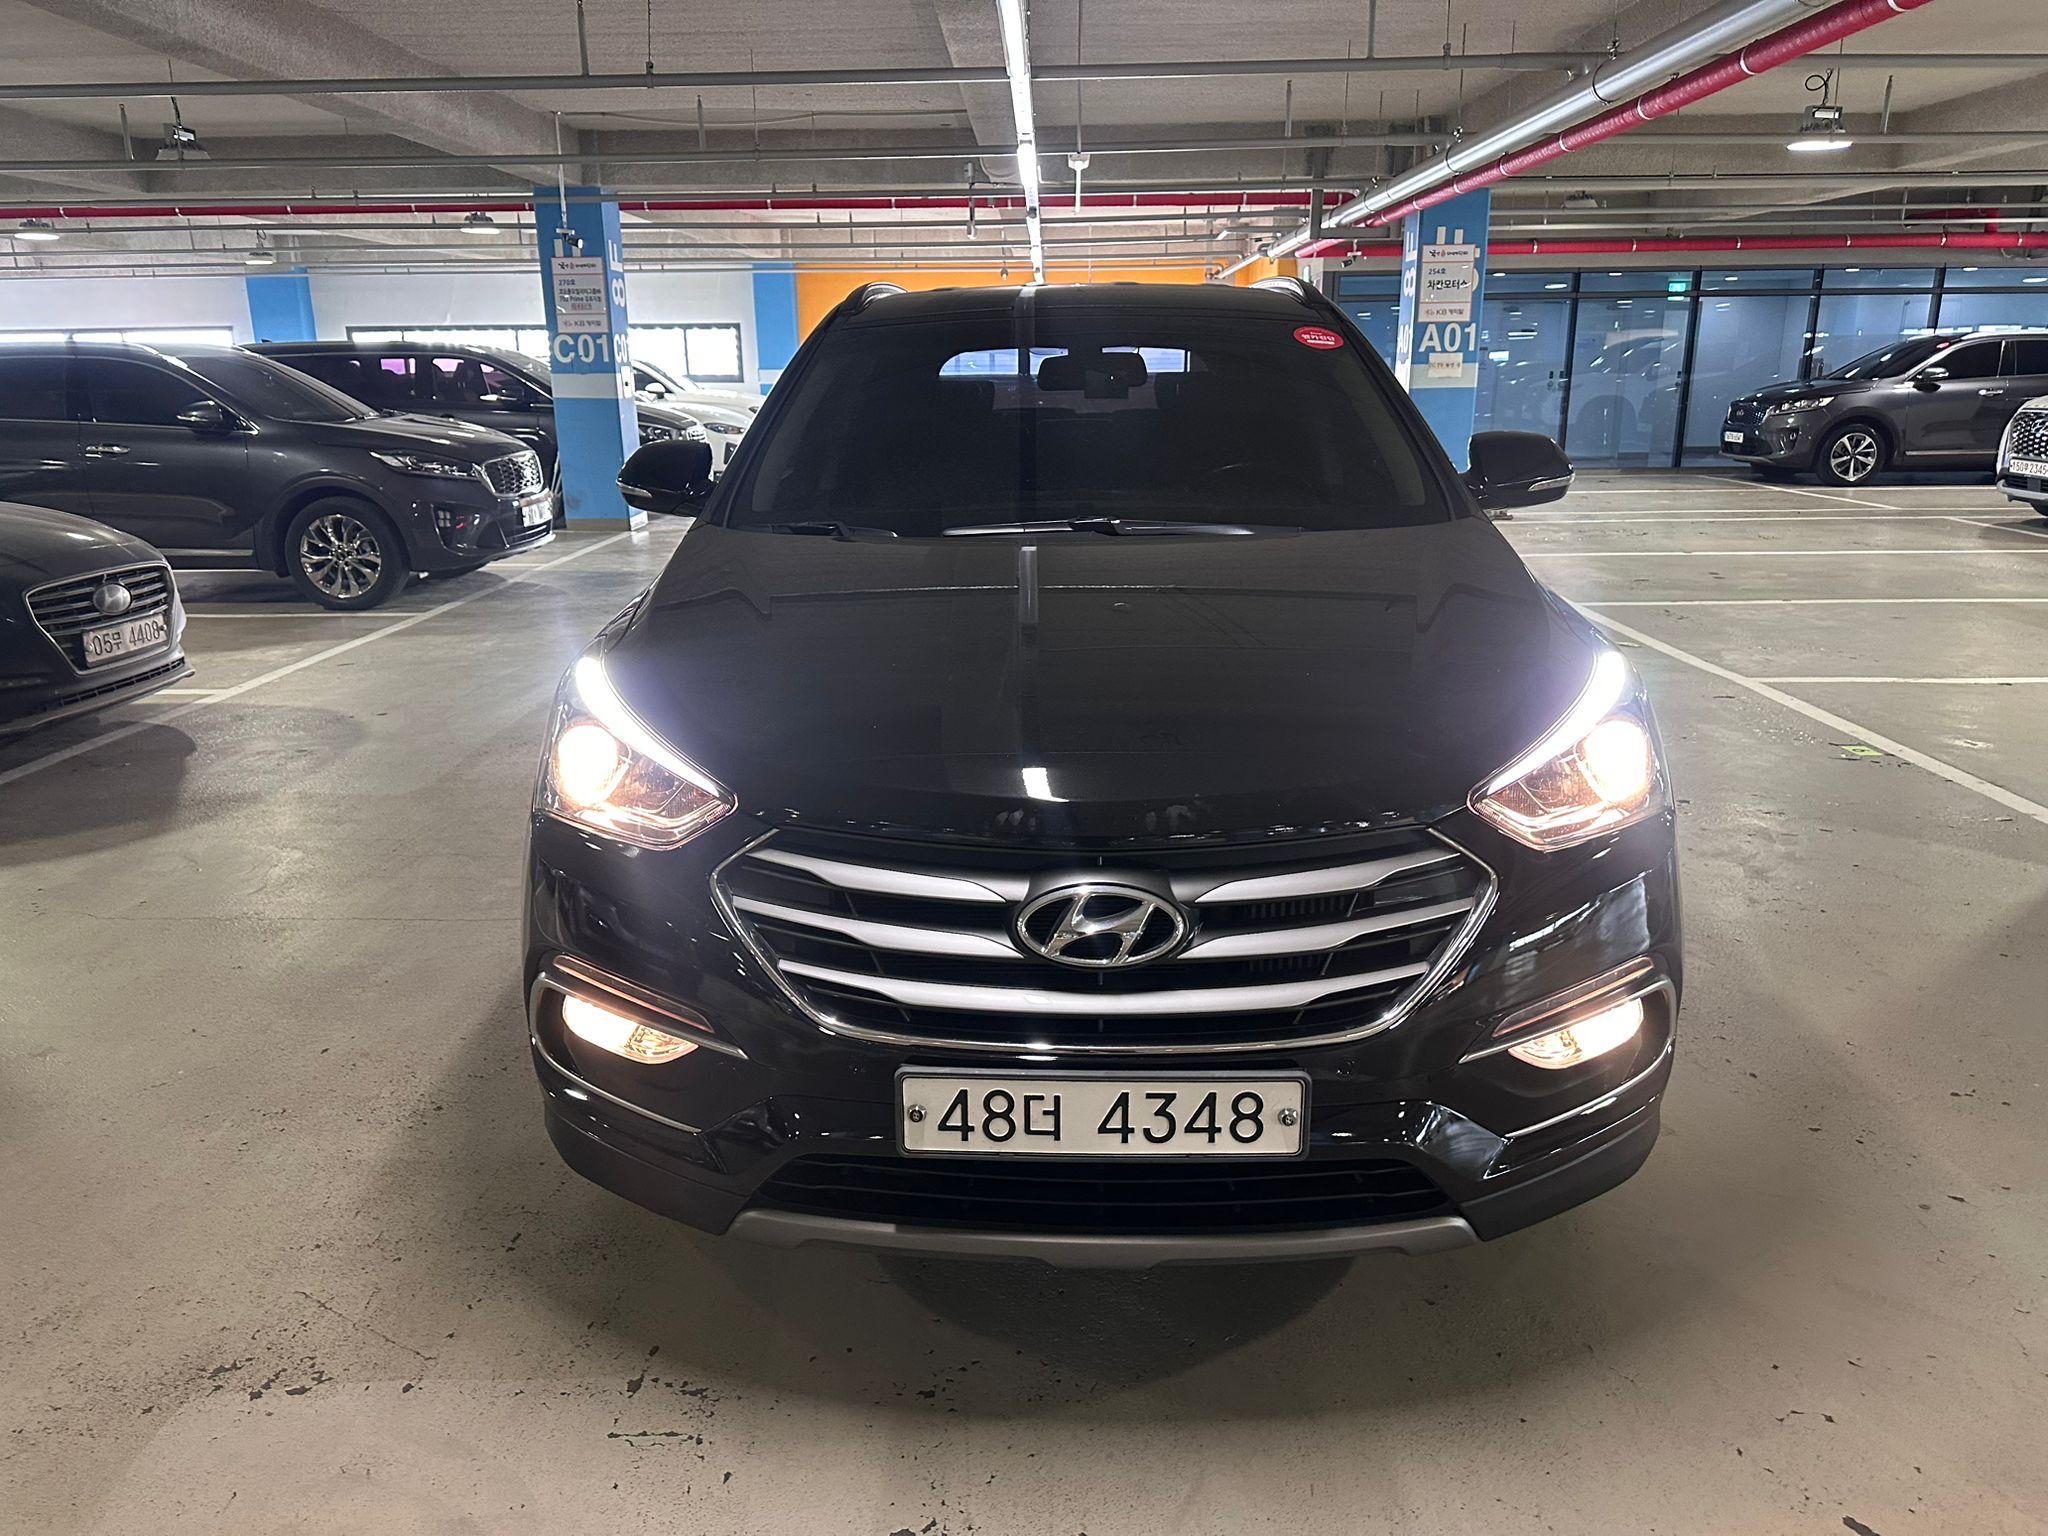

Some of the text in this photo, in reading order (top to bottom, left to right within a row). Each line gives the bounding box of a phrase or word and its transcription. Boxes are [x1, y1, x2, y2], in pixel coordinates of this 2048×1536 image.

[553, 333, 610, 363] C01
[1419, 322, 1477, 352] A01
[92, 620, 161, 656] 05무 4408
[937, 1088, 1265, 1144] 48더 4348
